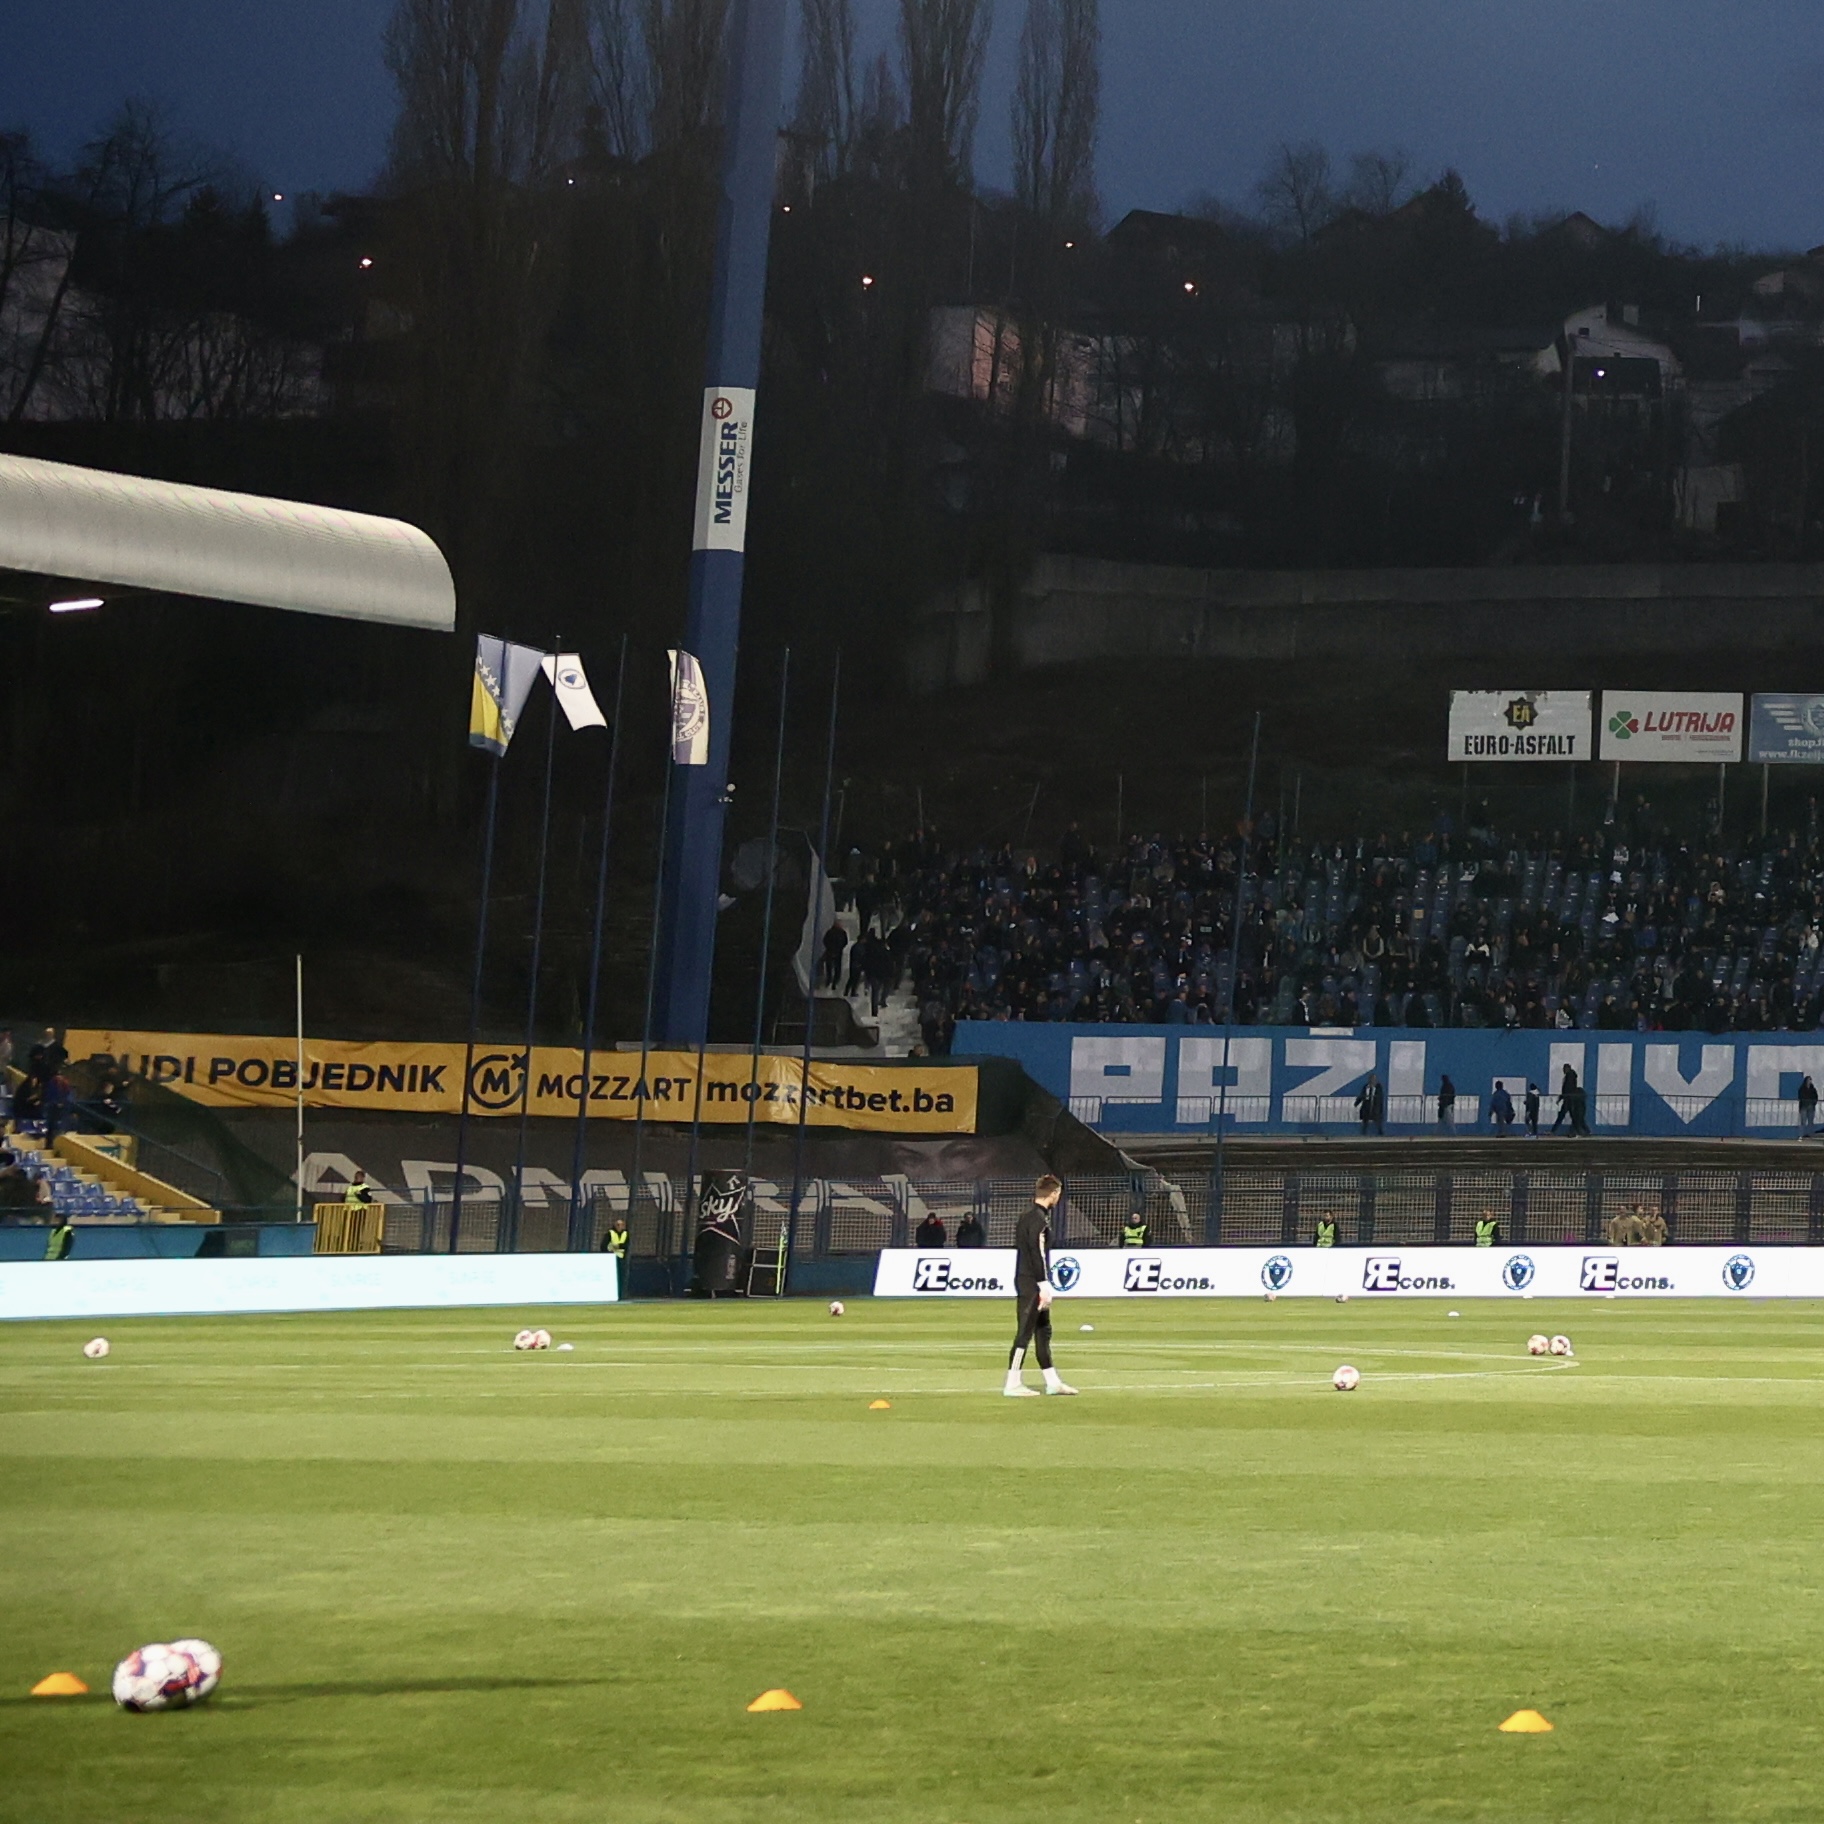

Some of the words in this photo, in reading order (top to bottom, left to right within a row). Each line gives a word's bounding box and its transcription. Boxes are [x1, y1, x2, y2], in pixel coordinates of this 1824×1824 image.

[738, 421, 748, 441] Life
[714, 421, 738, 524] MESSER
[734, 463, 744, 493] Gases
[1644, 711, 1735, 733] LUTRIJA
[1464, 735, 1576, 755] EURO-ASFALT
[208, 1057, 446, 1094] POBJEDNIK
[536, 1073, 692, 1102] MOZZART
[706, 1078, 955, 1114] mozzartbet.ba
[699, 1194, 739, 1223] sky
